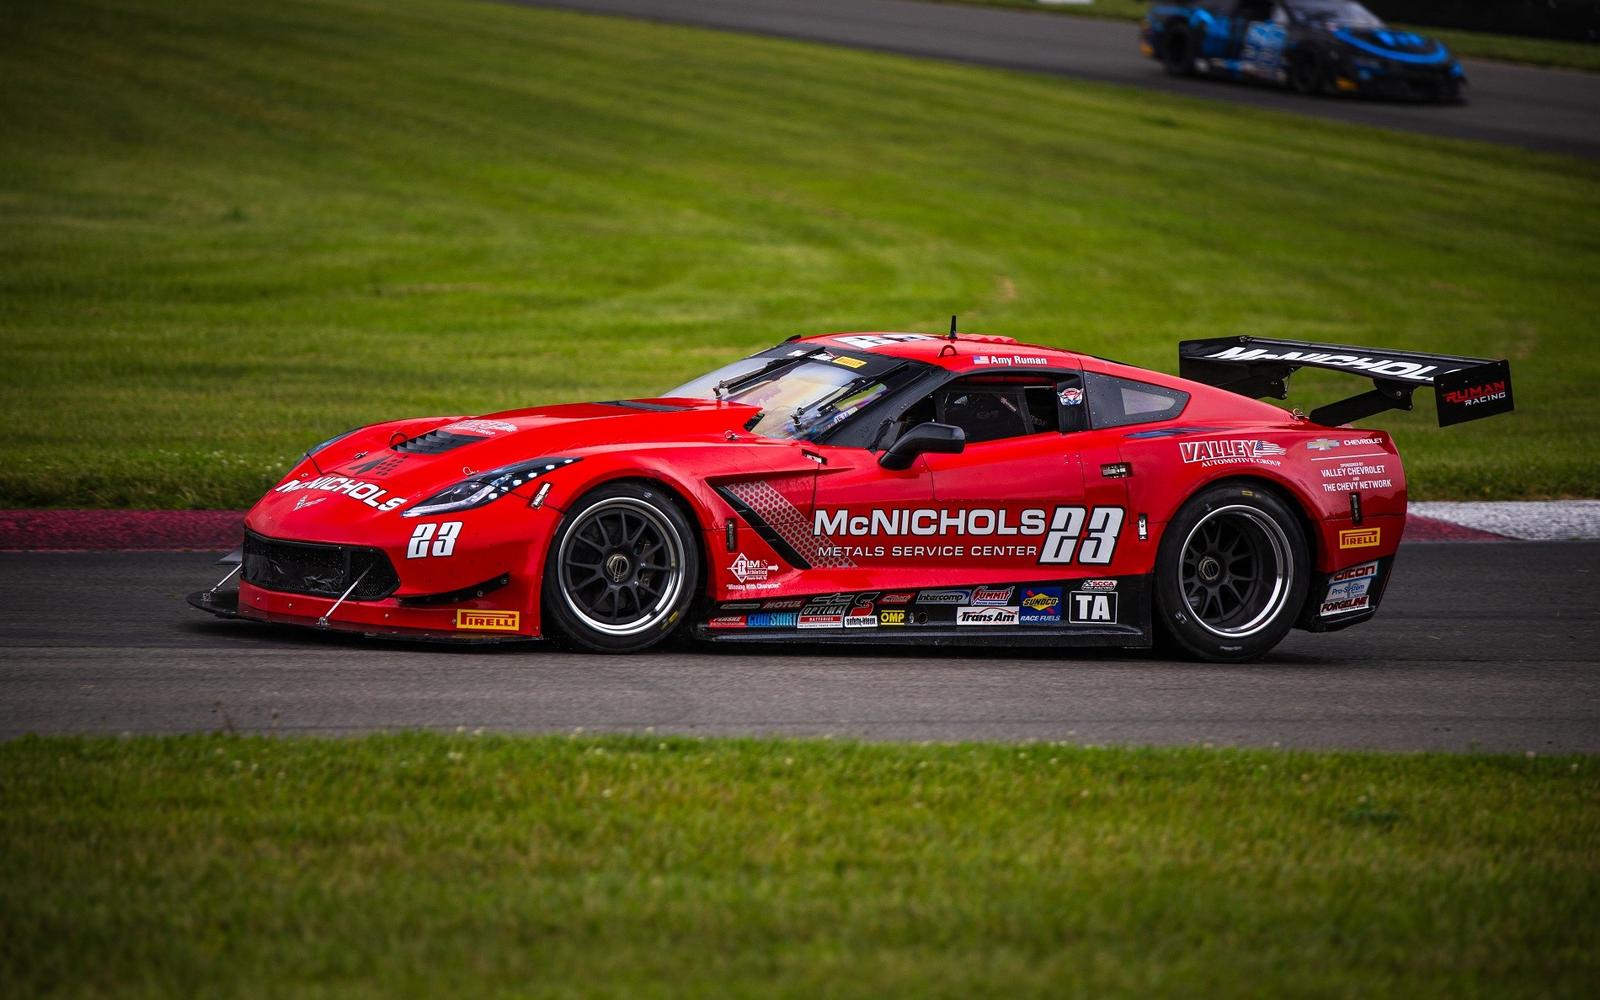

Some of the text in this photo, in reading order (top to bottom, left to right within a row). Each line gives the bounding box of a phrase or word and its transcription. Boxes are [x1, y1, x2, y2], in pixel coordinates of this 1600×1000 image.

[991, 355, 1048, 367] Amy Ruman
[1205, 345, 1461, 381] McNICHOL
[1446, 380, 1505, 403] RUMAN
[1464, 391, 1506, 406] RACING
[1343, 437, 1383, 447] CHEVROLET
[1179, 440, 1258, 463] VALLEY
[1201, 457, 1282, 468] AUTOMOTIVE GROUP
[1321, 465, 1385, 478] VALLEY CHEVROLET
[1323, 479, 1393, 492] THE CHEVY NETWORK
[407, 520, 463, 559] 23
[813, 506, 1126, 565] McNICHOLS 23
[1341, 530, 1378, 546] PIRELLI
[817, 545, 1038, 558] METALS SERVICE CENTER
[1092, 579, 1115, 587] SCCA
[918, 593, 963, 603] Intercomp
[970, 586, 1013, 606] SUMMIT
[1023, 598, 1058, 607] SUNOCO
[763, 600, 801, 610] MOTUL
[803, 606, 843, 615] OPTIMA
[1075, 594, 1112, 621] TA
[1320, 596, 1368, 613] FORGELINE
[460, 611, 517, 628] PIRELLI
[880, 612, 905, 623] OMP
[962, 610, 1015, 623] Trans Am
